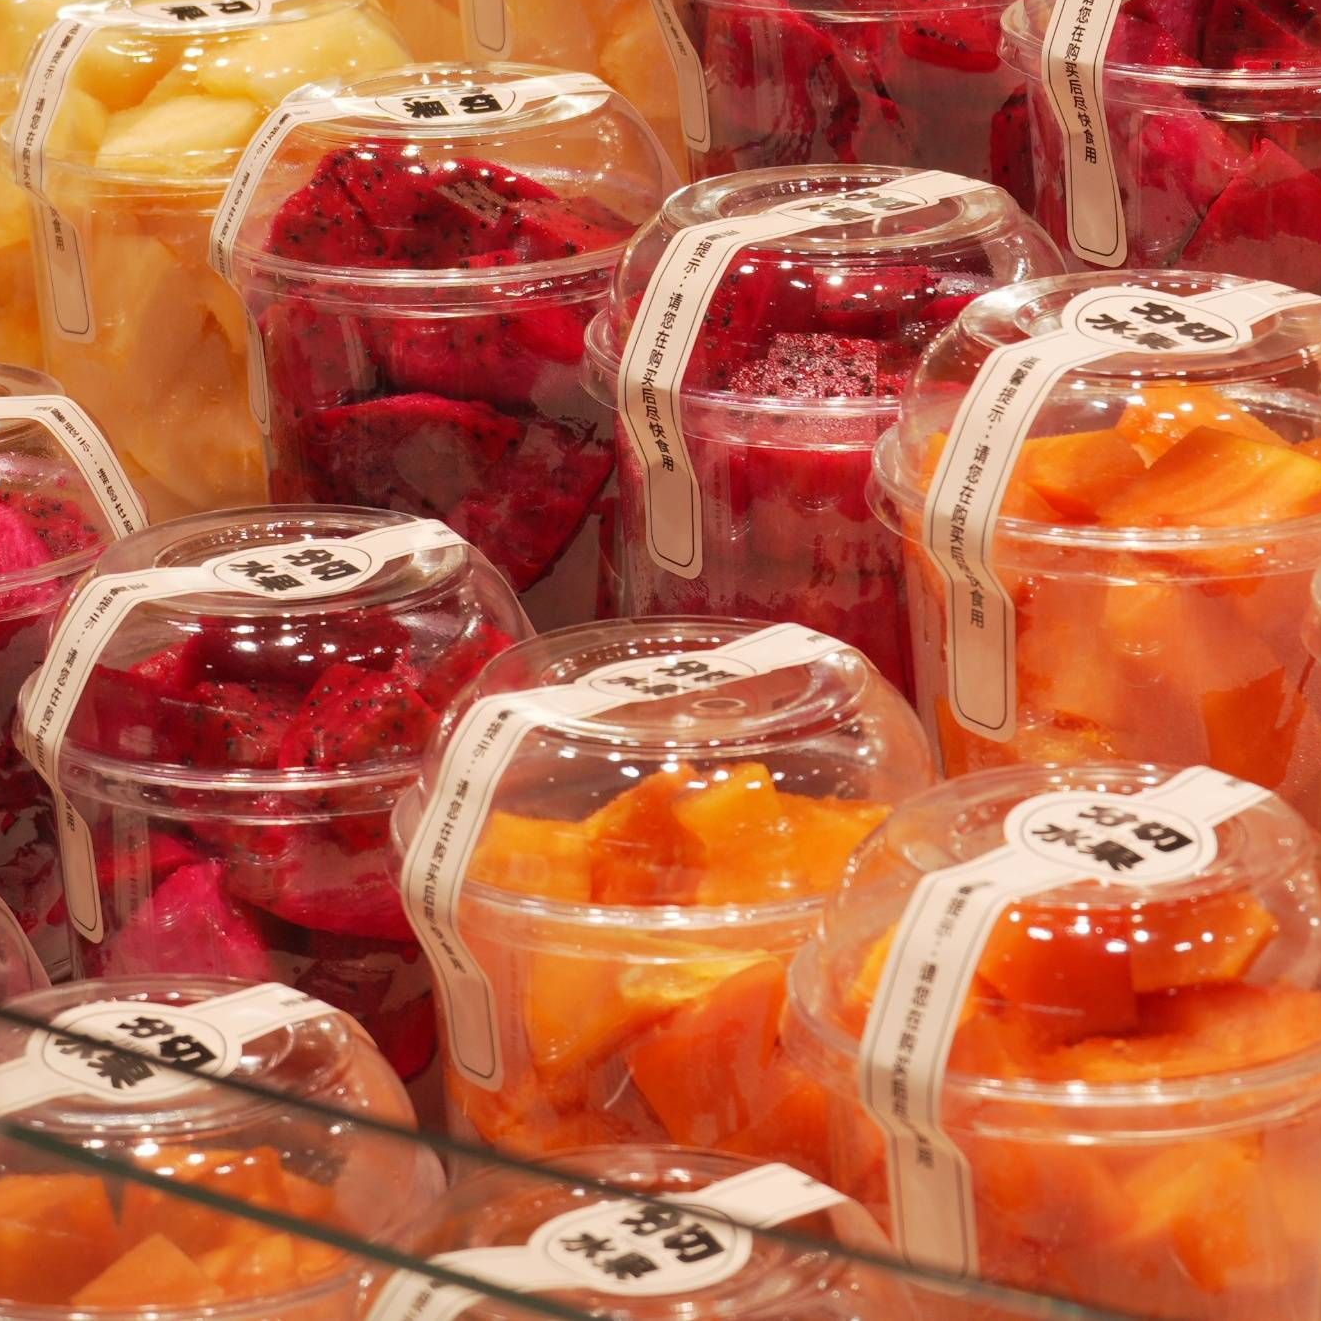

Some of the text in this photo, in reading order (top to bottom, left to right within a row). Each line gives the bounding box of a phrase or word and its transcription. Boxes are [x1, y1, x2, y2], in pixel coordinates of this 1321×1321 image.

[1085, 314, 1181, 350] 水果
[1130, 303, 1234, 342] 分切
[1032, 824, 1145, 872] 水果
